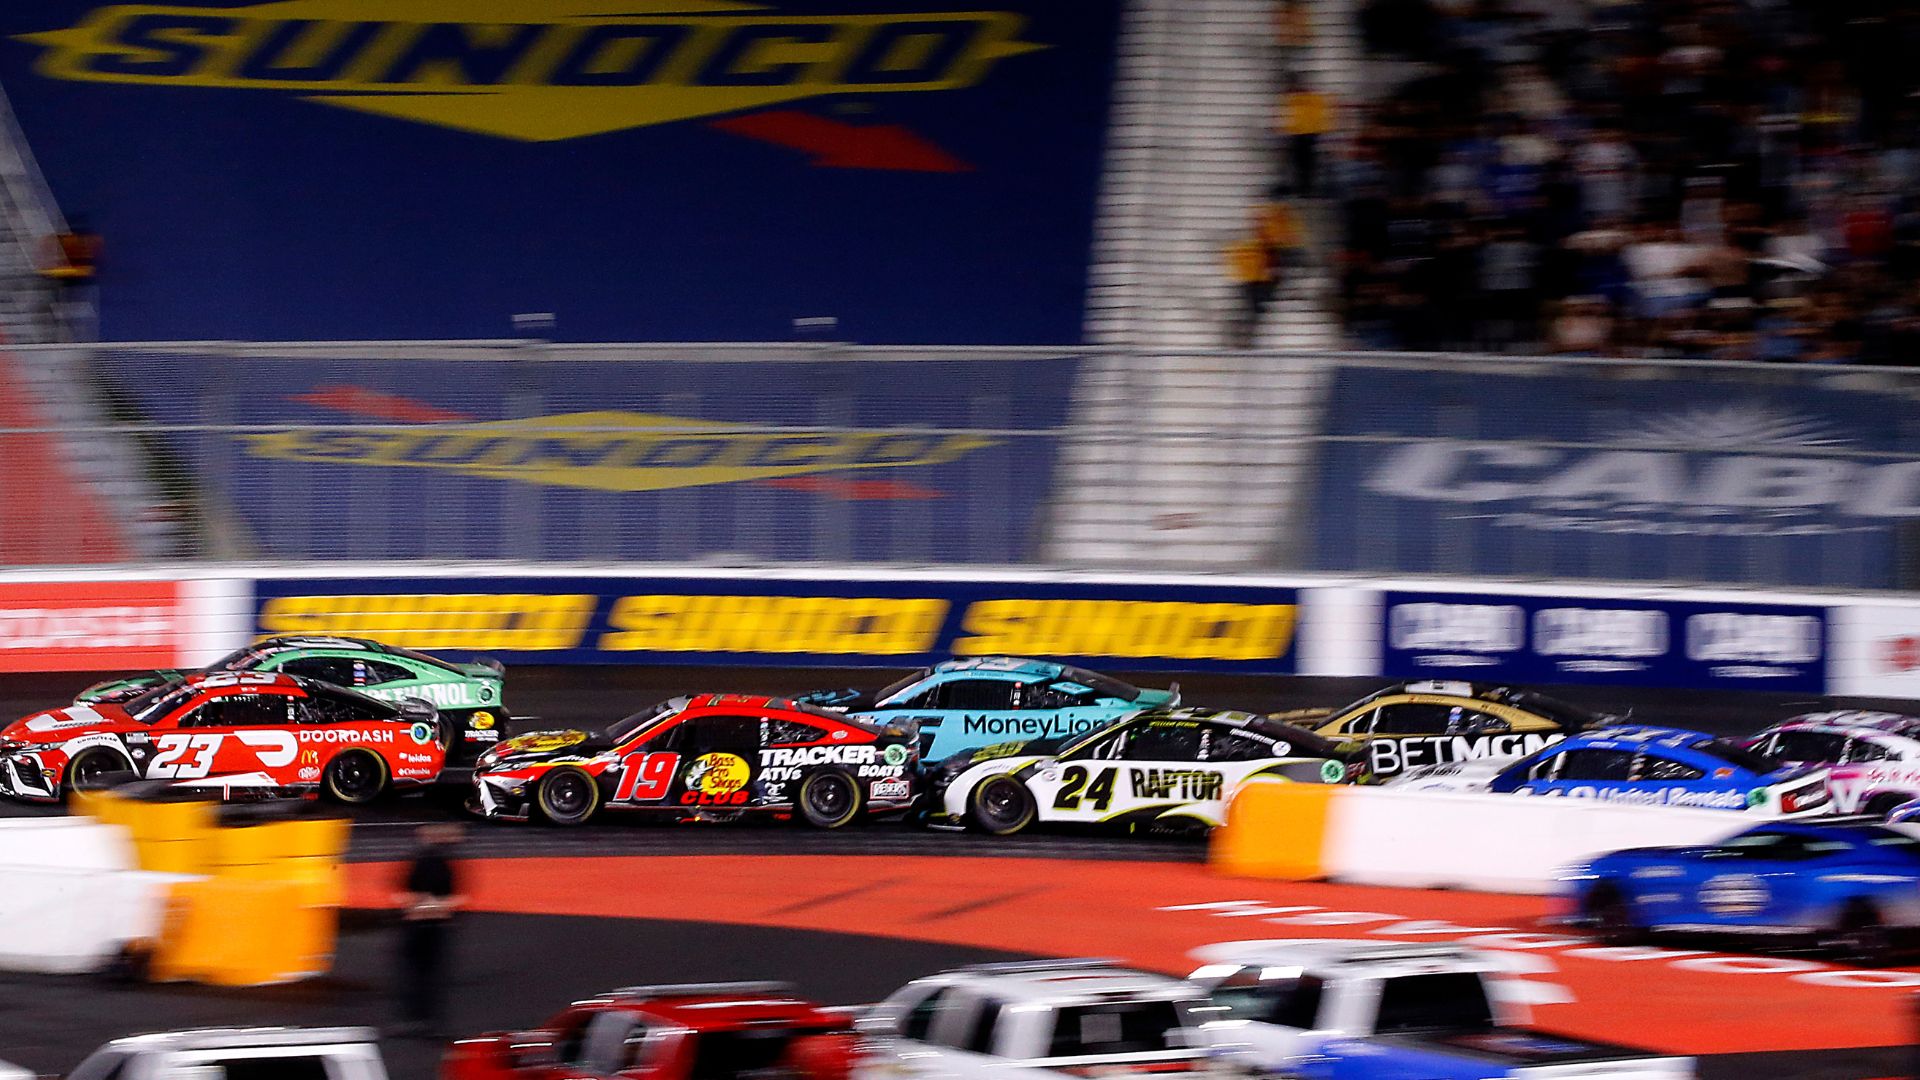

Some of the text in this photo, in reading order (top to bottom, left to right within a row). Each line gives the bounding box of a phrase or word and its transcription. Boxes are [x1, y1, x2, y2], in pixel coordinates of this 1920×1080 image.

[80, 13, 985, 86] SUNOCO
[290, 430, 940, 467] SUNOCO
[600, 595, 949, 654] SUNOCO
[952, 600, 1295, 660] SUNOCO
[300, 729, 393, 743] DOORDASH
[964, 713, 1106, 739] MoneyLion
[145, 733, 222, 779] 23
[709, 754, 736, 767] Bass
[758, 745, 876, 766] TRACKER
[1371, 733, 1567, 774] BETMGM
[612, 751, 682, 801] 19
[710, 767, 729, 777] Pro
[710, 776, 741, 789] Shops
[858, 765, 904, 777] BOATS
[1129, 768, 1224, 800] RAPTOR
[680, 791, 749, 805] CLUB
[1052, 765, 1119, 813] 24
